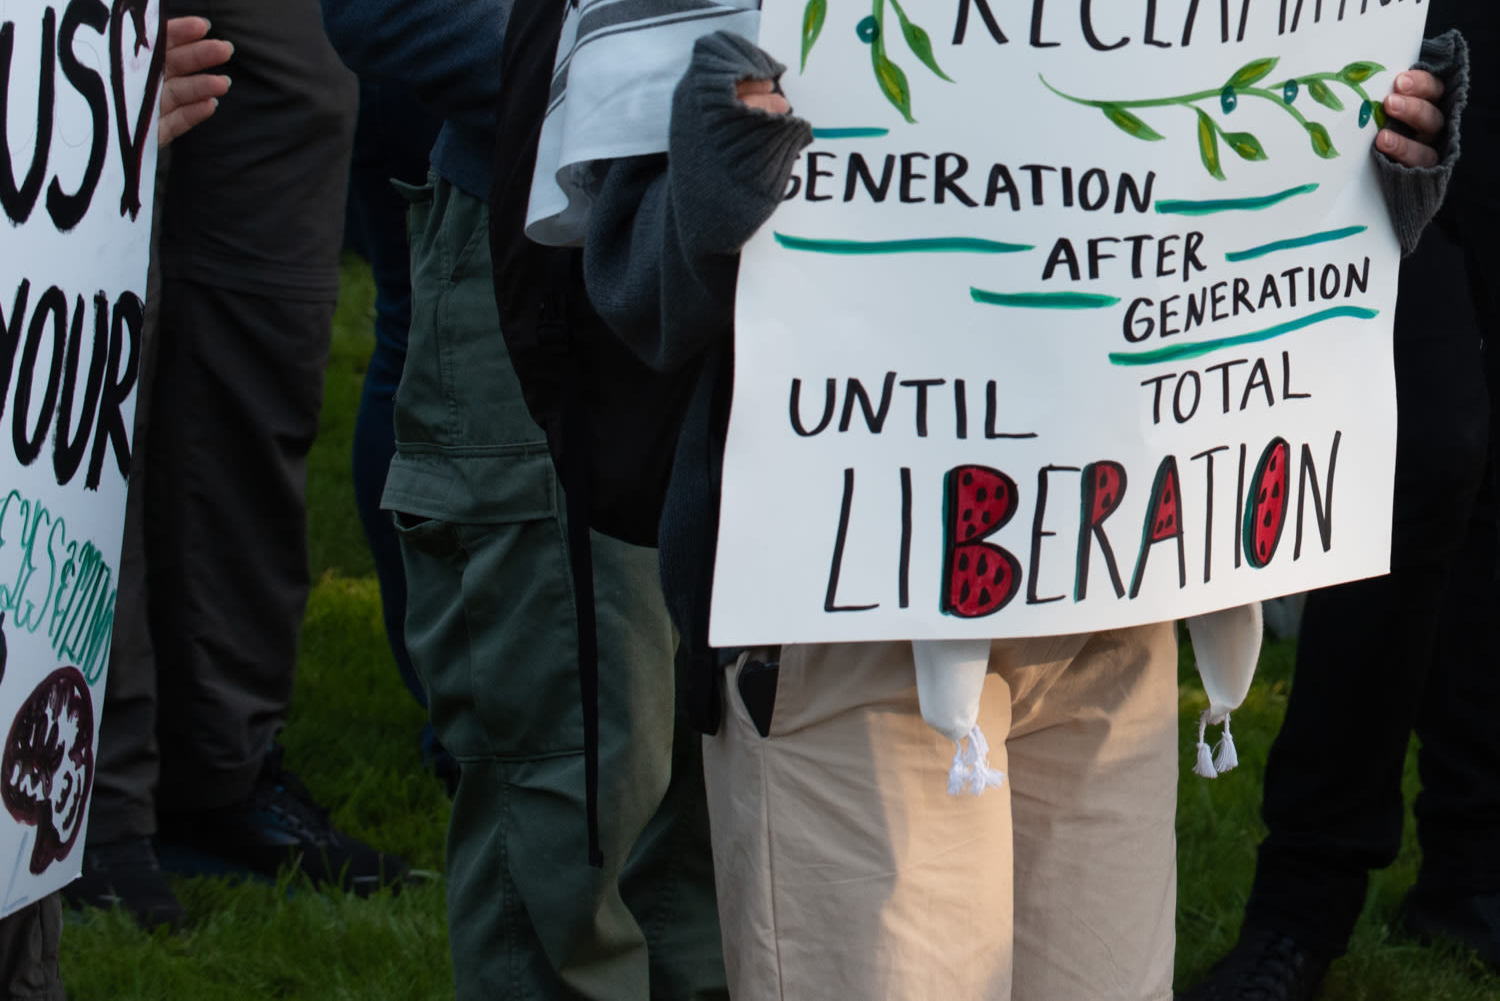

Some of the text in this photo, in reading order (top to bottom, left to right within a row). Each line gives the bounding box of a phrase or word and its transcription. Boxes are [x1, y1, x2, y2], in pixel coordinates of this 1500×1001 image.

[1041, 231, 1208, 281] AFTER
[1122, 256, 1371, 343] GENERATION
[789, 351, 1312, 439] UNTIL TOTAL
[823, 430, 1343, 619] LIBERATION
